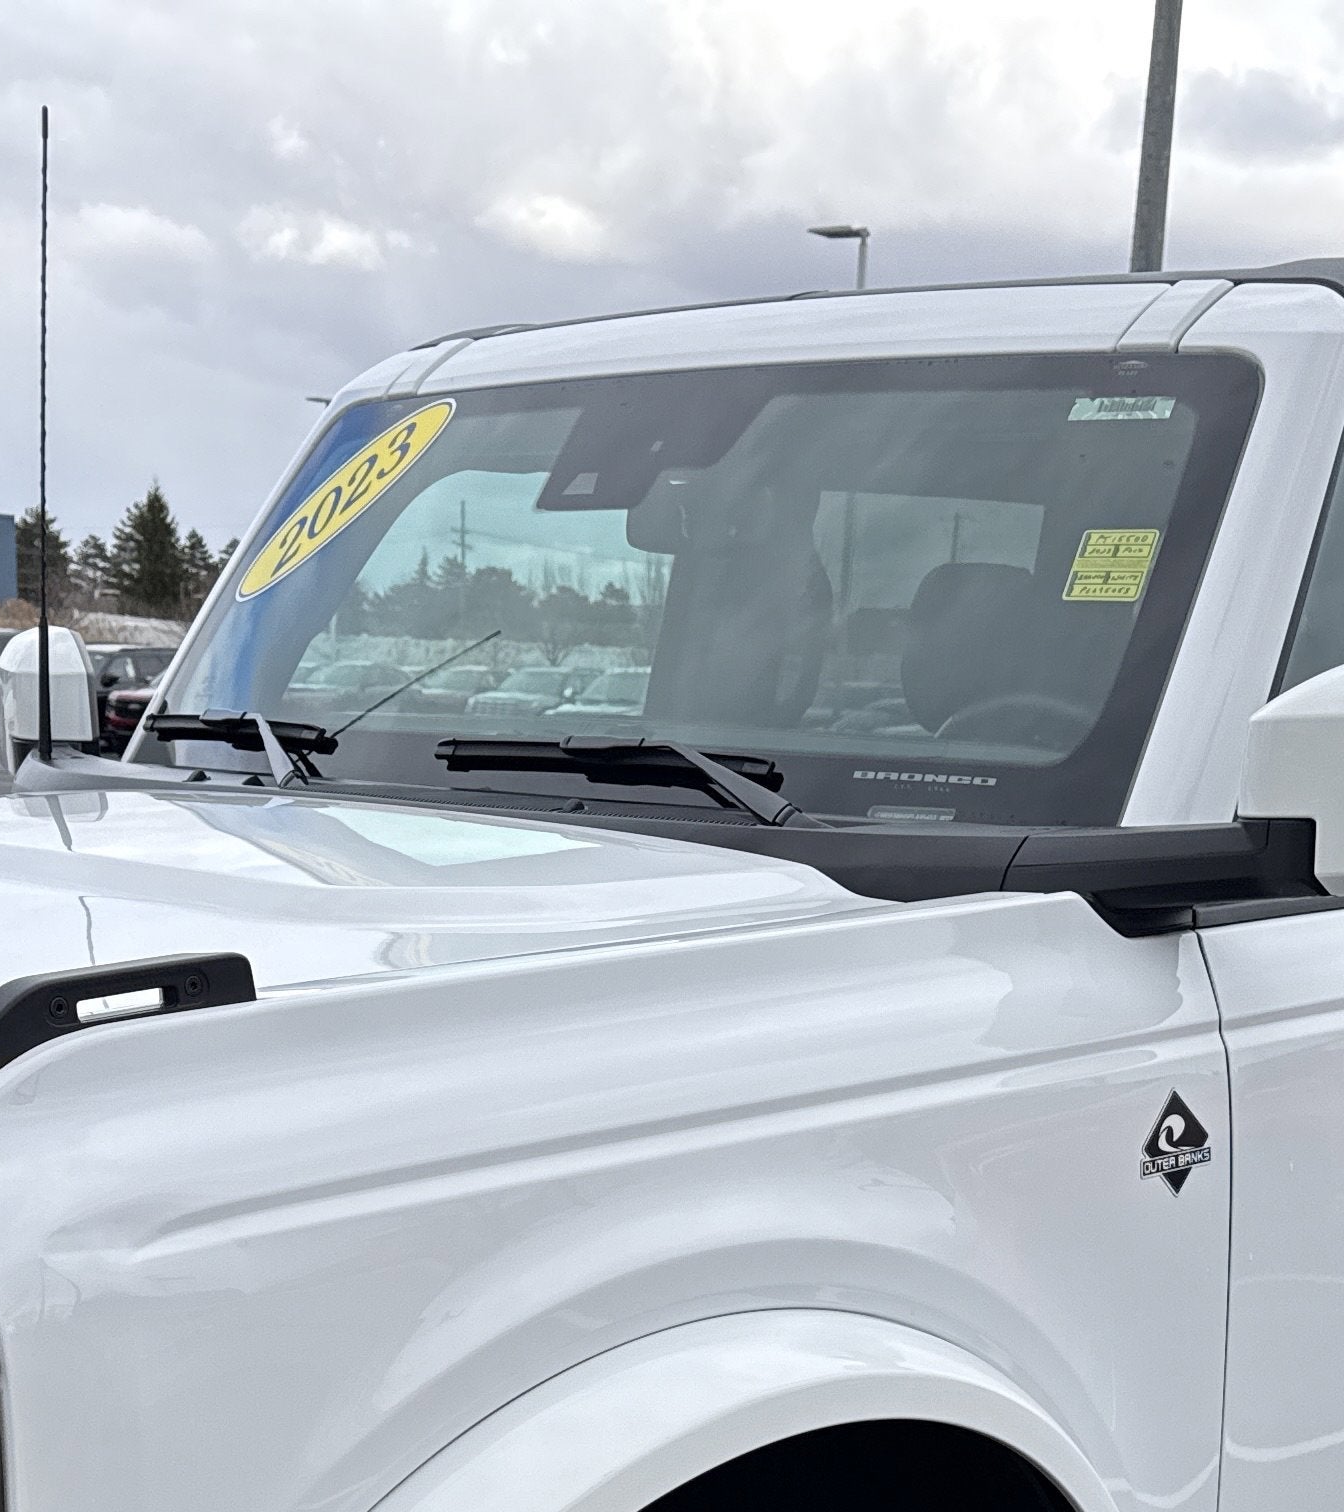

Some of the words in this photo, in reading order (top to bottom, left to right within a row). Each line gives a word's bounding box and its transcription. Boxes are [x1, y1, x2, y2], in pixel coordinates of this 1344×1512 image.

[270, 422, 417, 578] 2023
[852, 770, 998, 787] BRONCO
[1143, 1156, 1176, 1175] OUTER
[1177, 1149, 1211, 1167] BANKS
